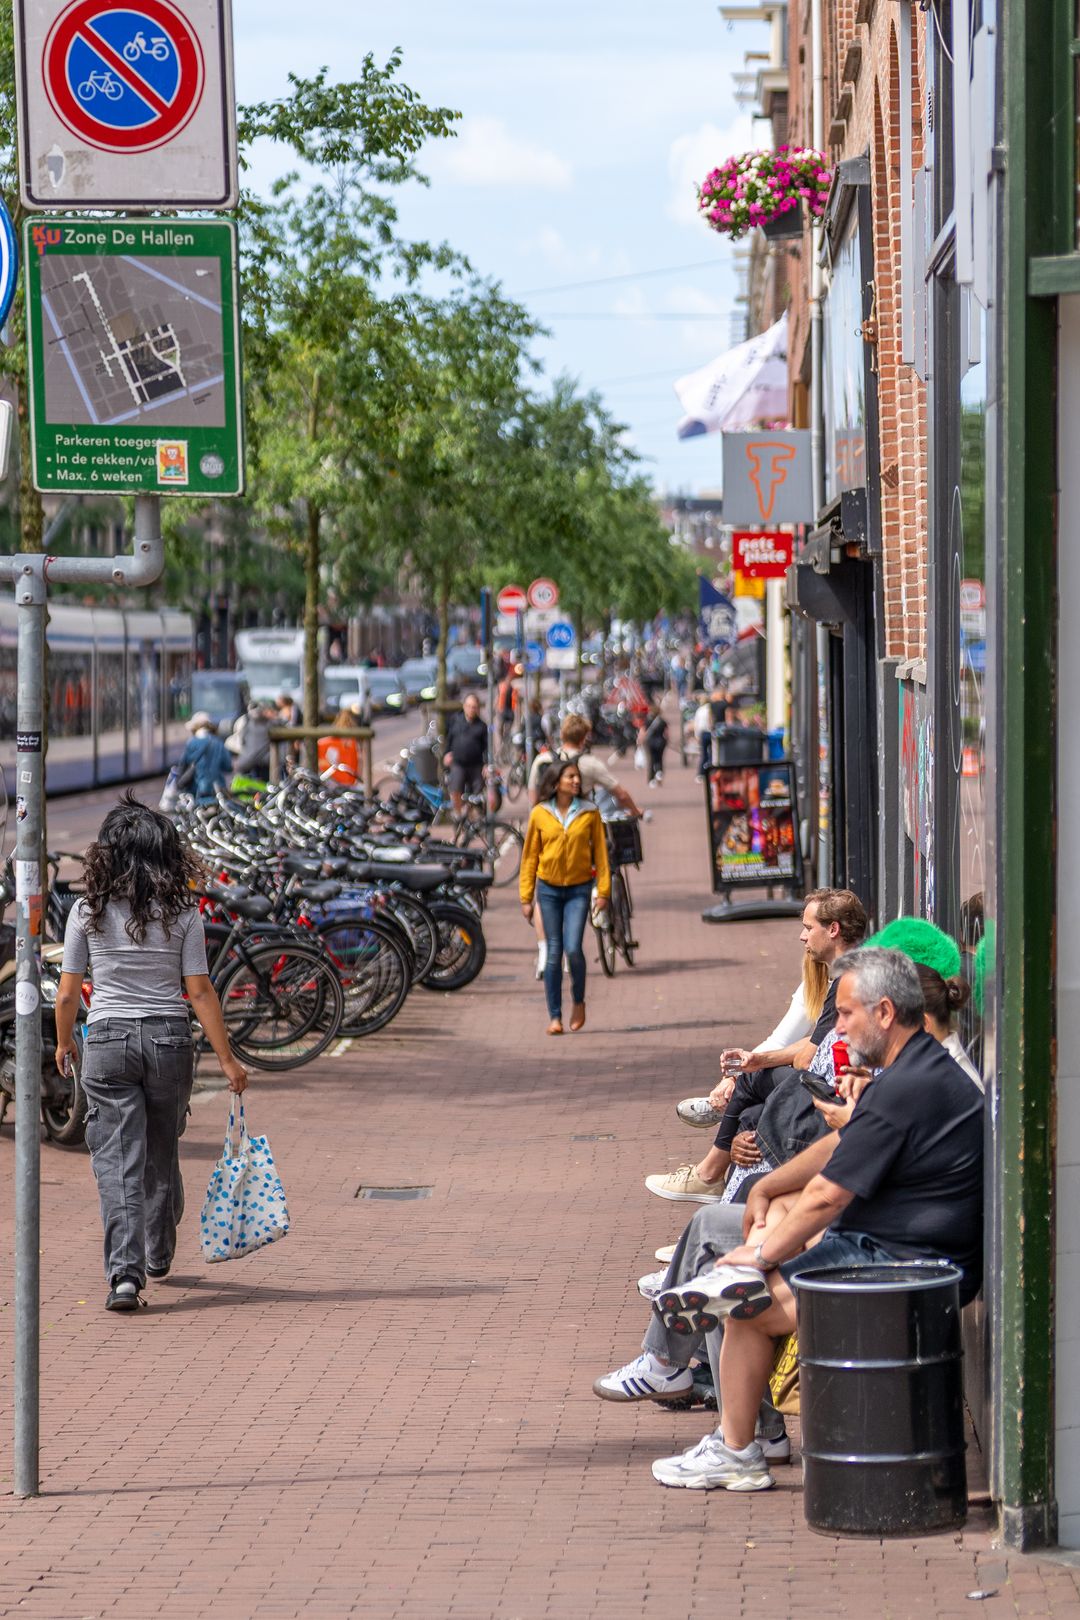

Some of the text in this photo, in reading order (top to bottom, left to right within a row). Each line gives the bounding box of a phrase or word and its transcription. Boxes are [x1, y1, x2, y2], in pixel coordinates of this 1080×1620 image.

[64, 229, 195, 246] Zone De Hallen
[55, 434, 159, 450] Parkeren toeges
[55, 453, 159, 467] In de rekken/va
[56, 469, 143, 482] Max. 6 weken
[738, 537, 775, 556] pets
